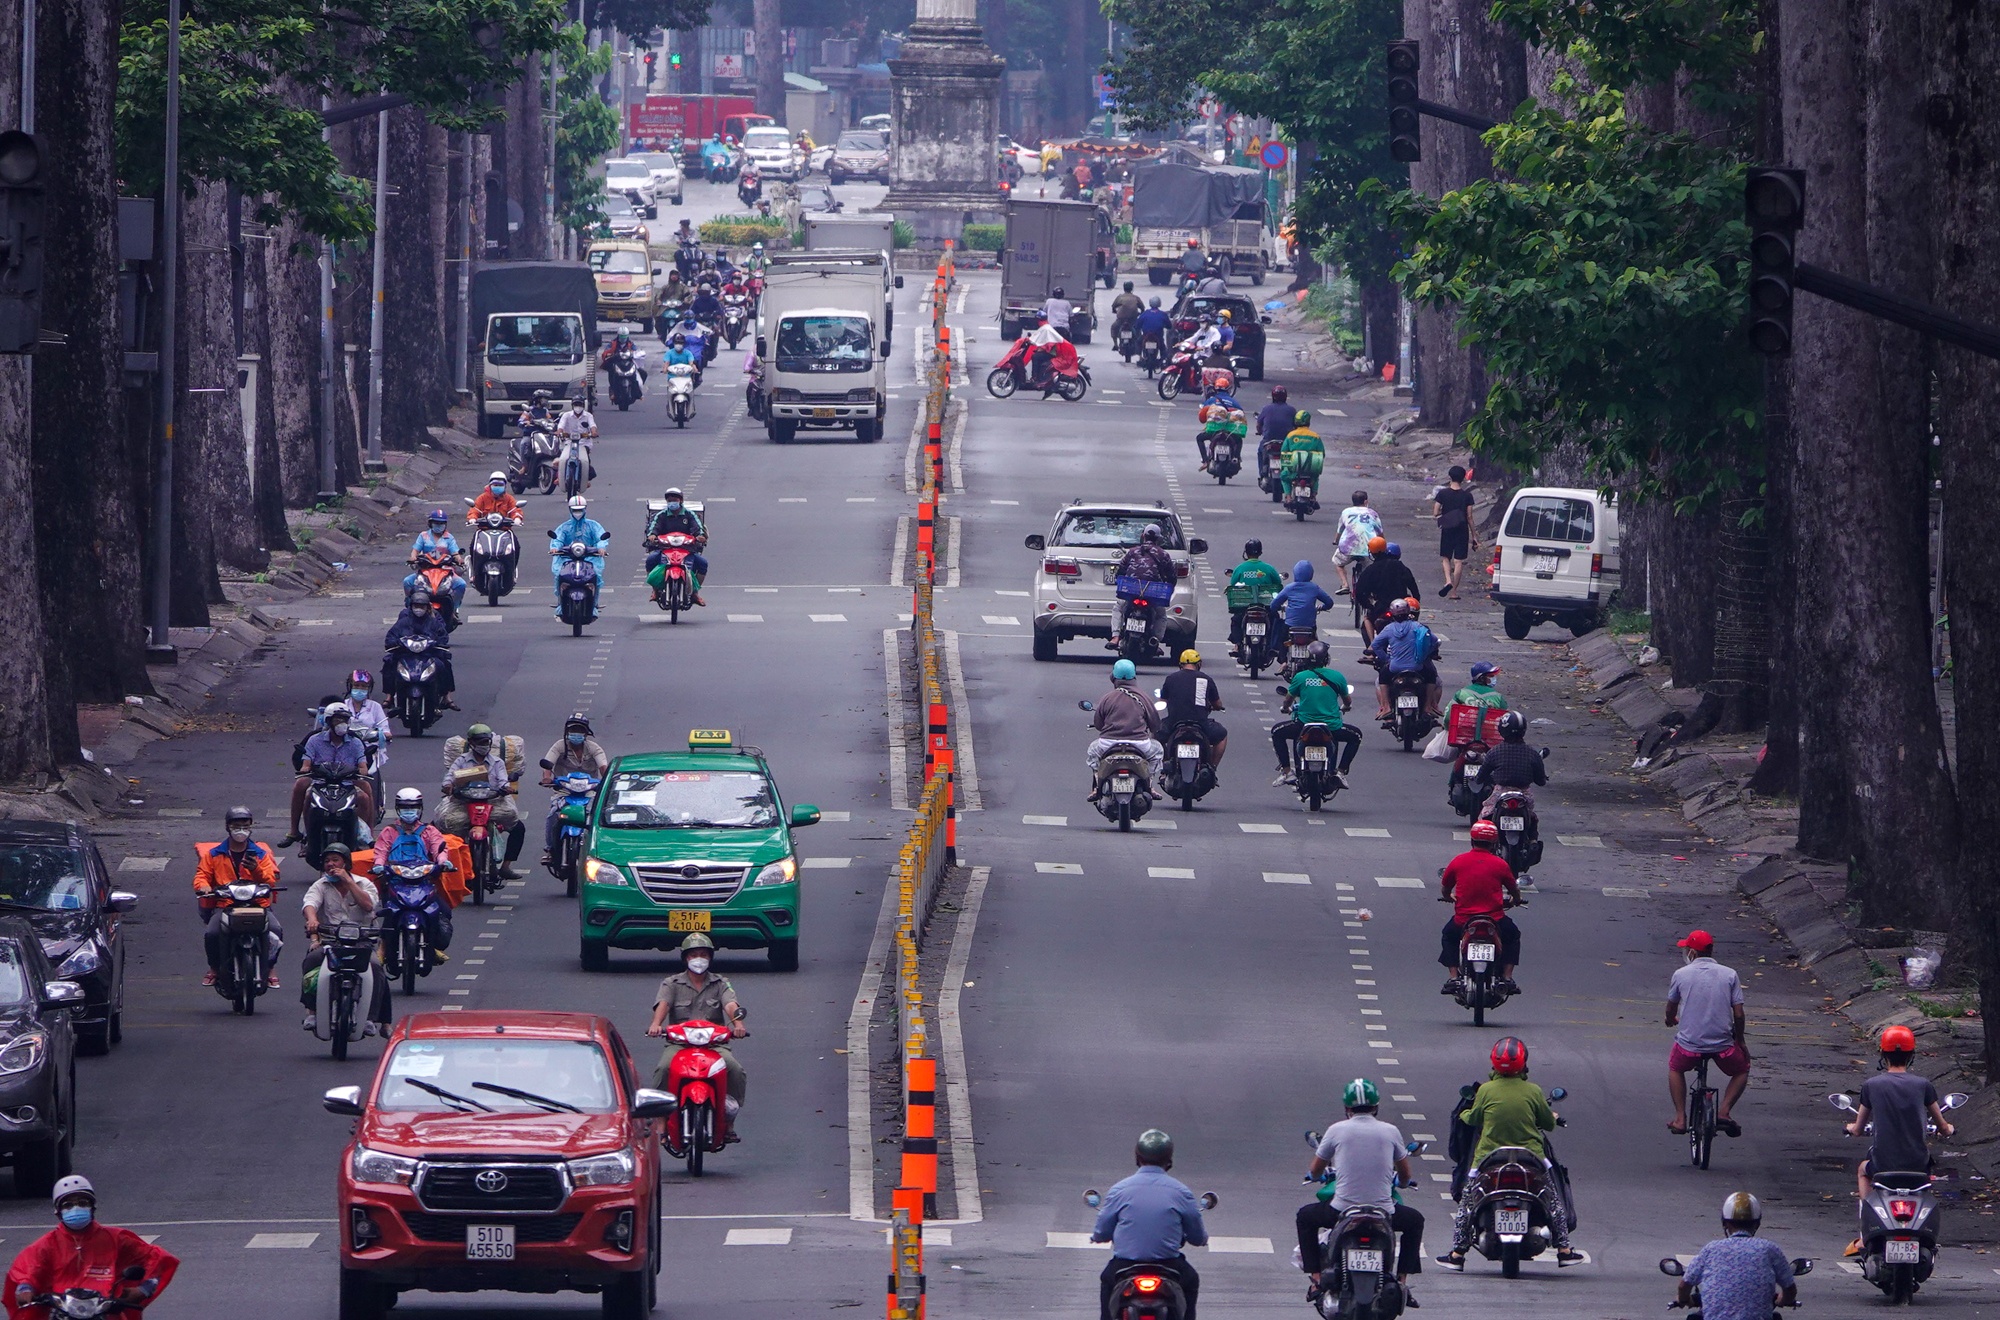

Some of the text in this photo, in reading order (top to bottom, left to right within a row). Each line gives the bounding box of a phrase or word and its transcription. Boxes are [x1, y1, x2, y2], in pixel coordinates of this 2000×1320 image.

[809, 363, 839, 371] ISUZU
[1348, 513, 1371, 525] 78
[681, 911, 699, 921] 51F
[673, 921, 706, 931] 410.04
[1471, 952, 1491, 960] 3483
[1500, 1211, 1521, 1222] 59-P1
[1497, 1222, 1526, 1231] 310.05
[478, 1227, 503, 1242] 51D
[468, 1243, 513, 1258] 455.50
[1891, 1242, 1914, 1252] 71-B2
[1354, 1251, 1377, 1261] 17-B4
[1350, 1260, 1381, 1271] 485.72
